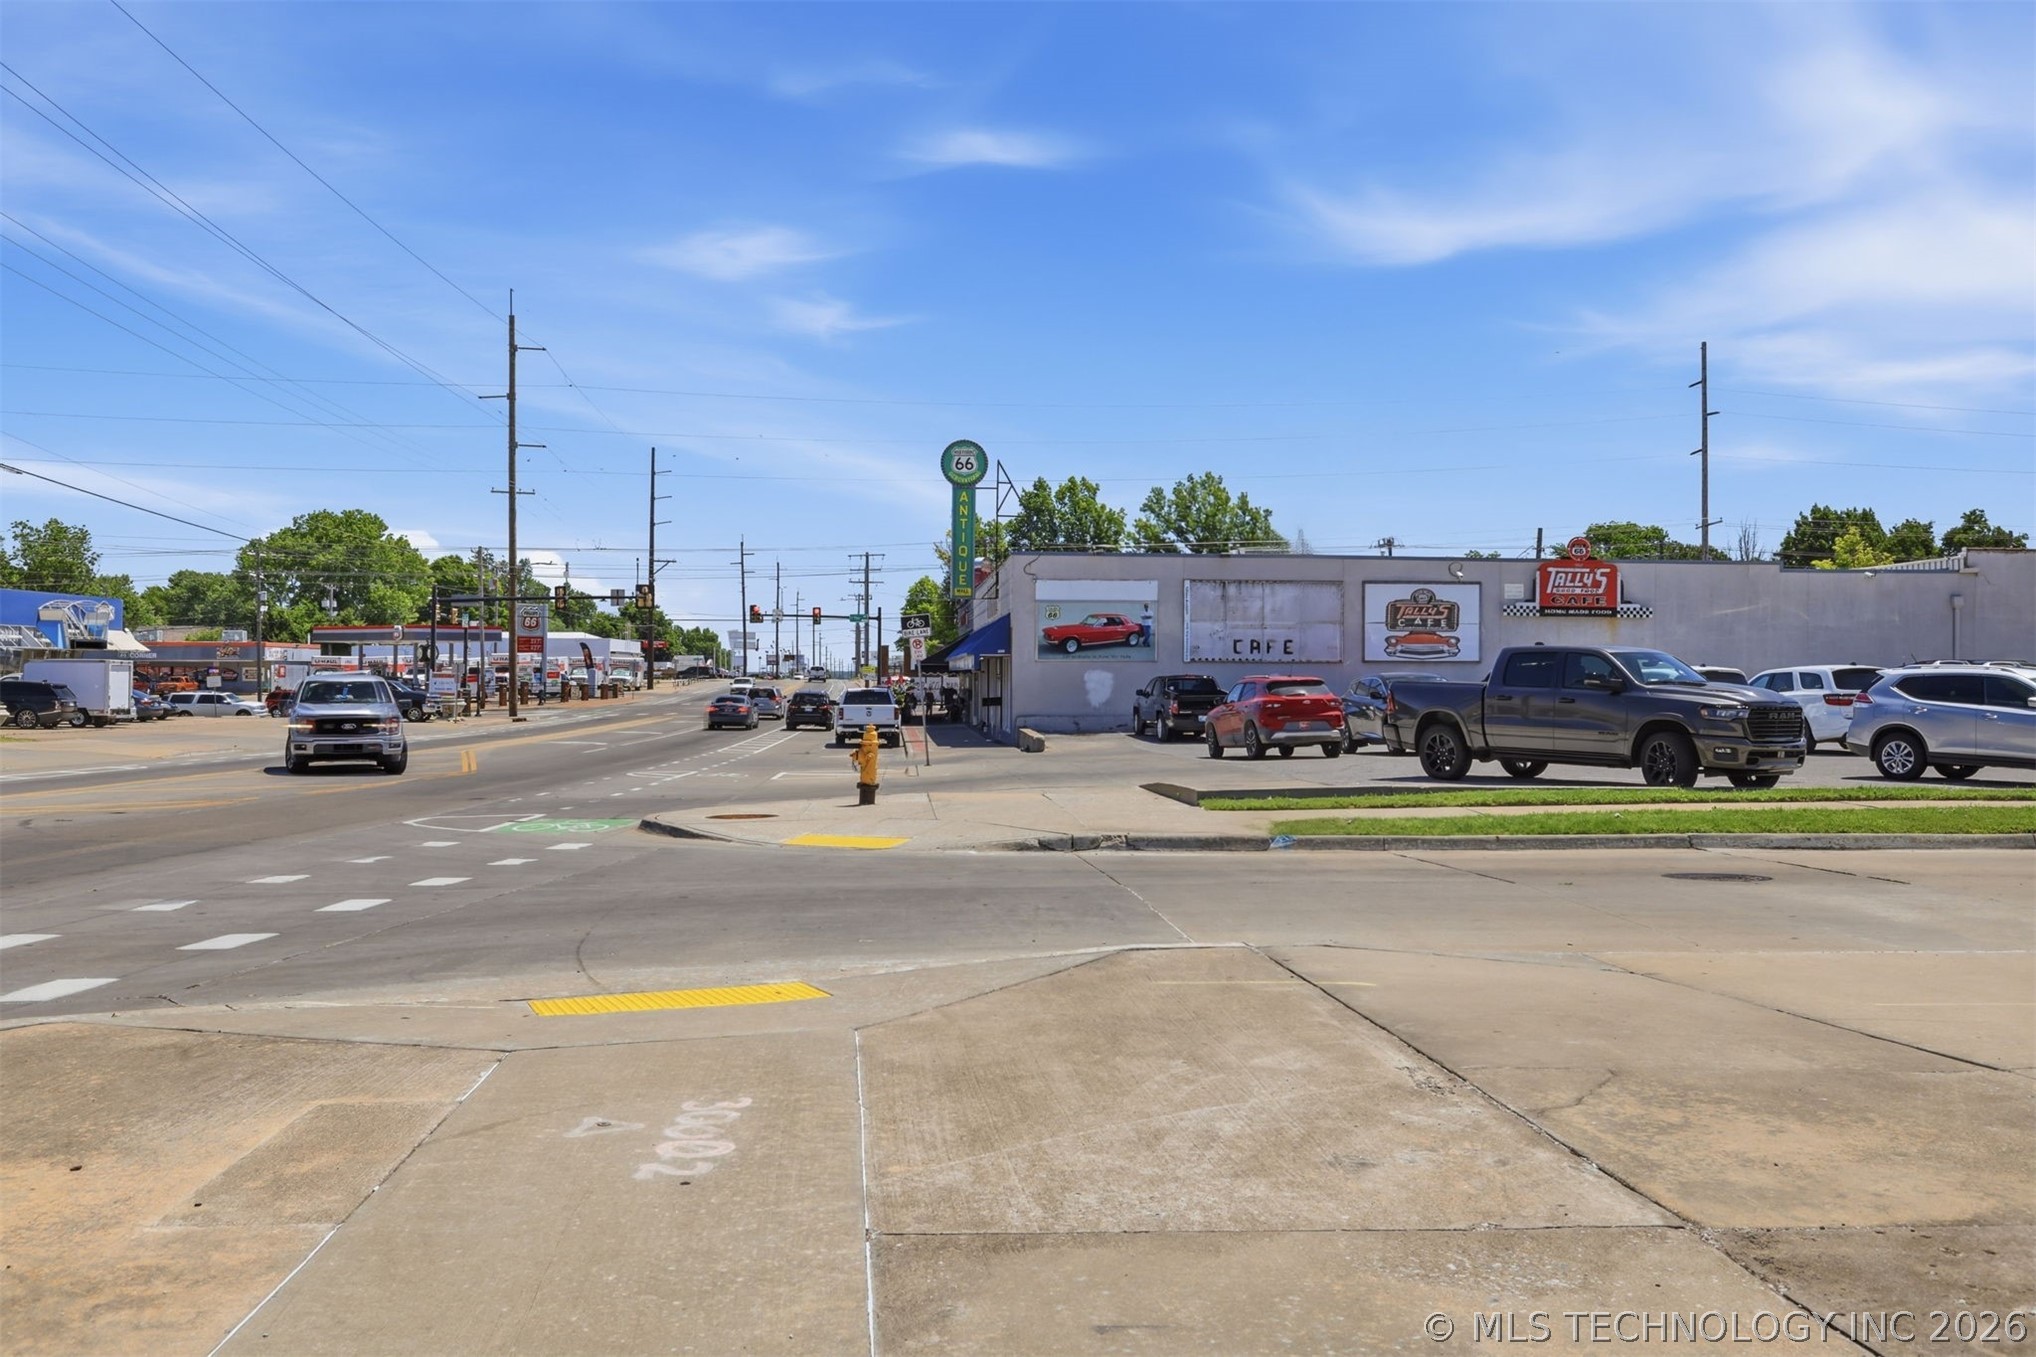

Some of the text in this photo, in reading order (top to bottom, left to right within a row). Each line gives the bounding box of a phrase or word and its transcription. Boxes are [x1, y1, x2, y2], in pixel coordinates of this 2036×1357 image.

[955, 457, 974, 471] 66
[958, 491, 969, 585] ANTIQUE
[1550, 595, 1607, 606] CAFE
[524, 617, 537, 627] 66
[1397, 616, 1447, 628] CAFE
[1233, 639, 1294, 655] CAFE
[1768, 712, 1795, 720] RAM
